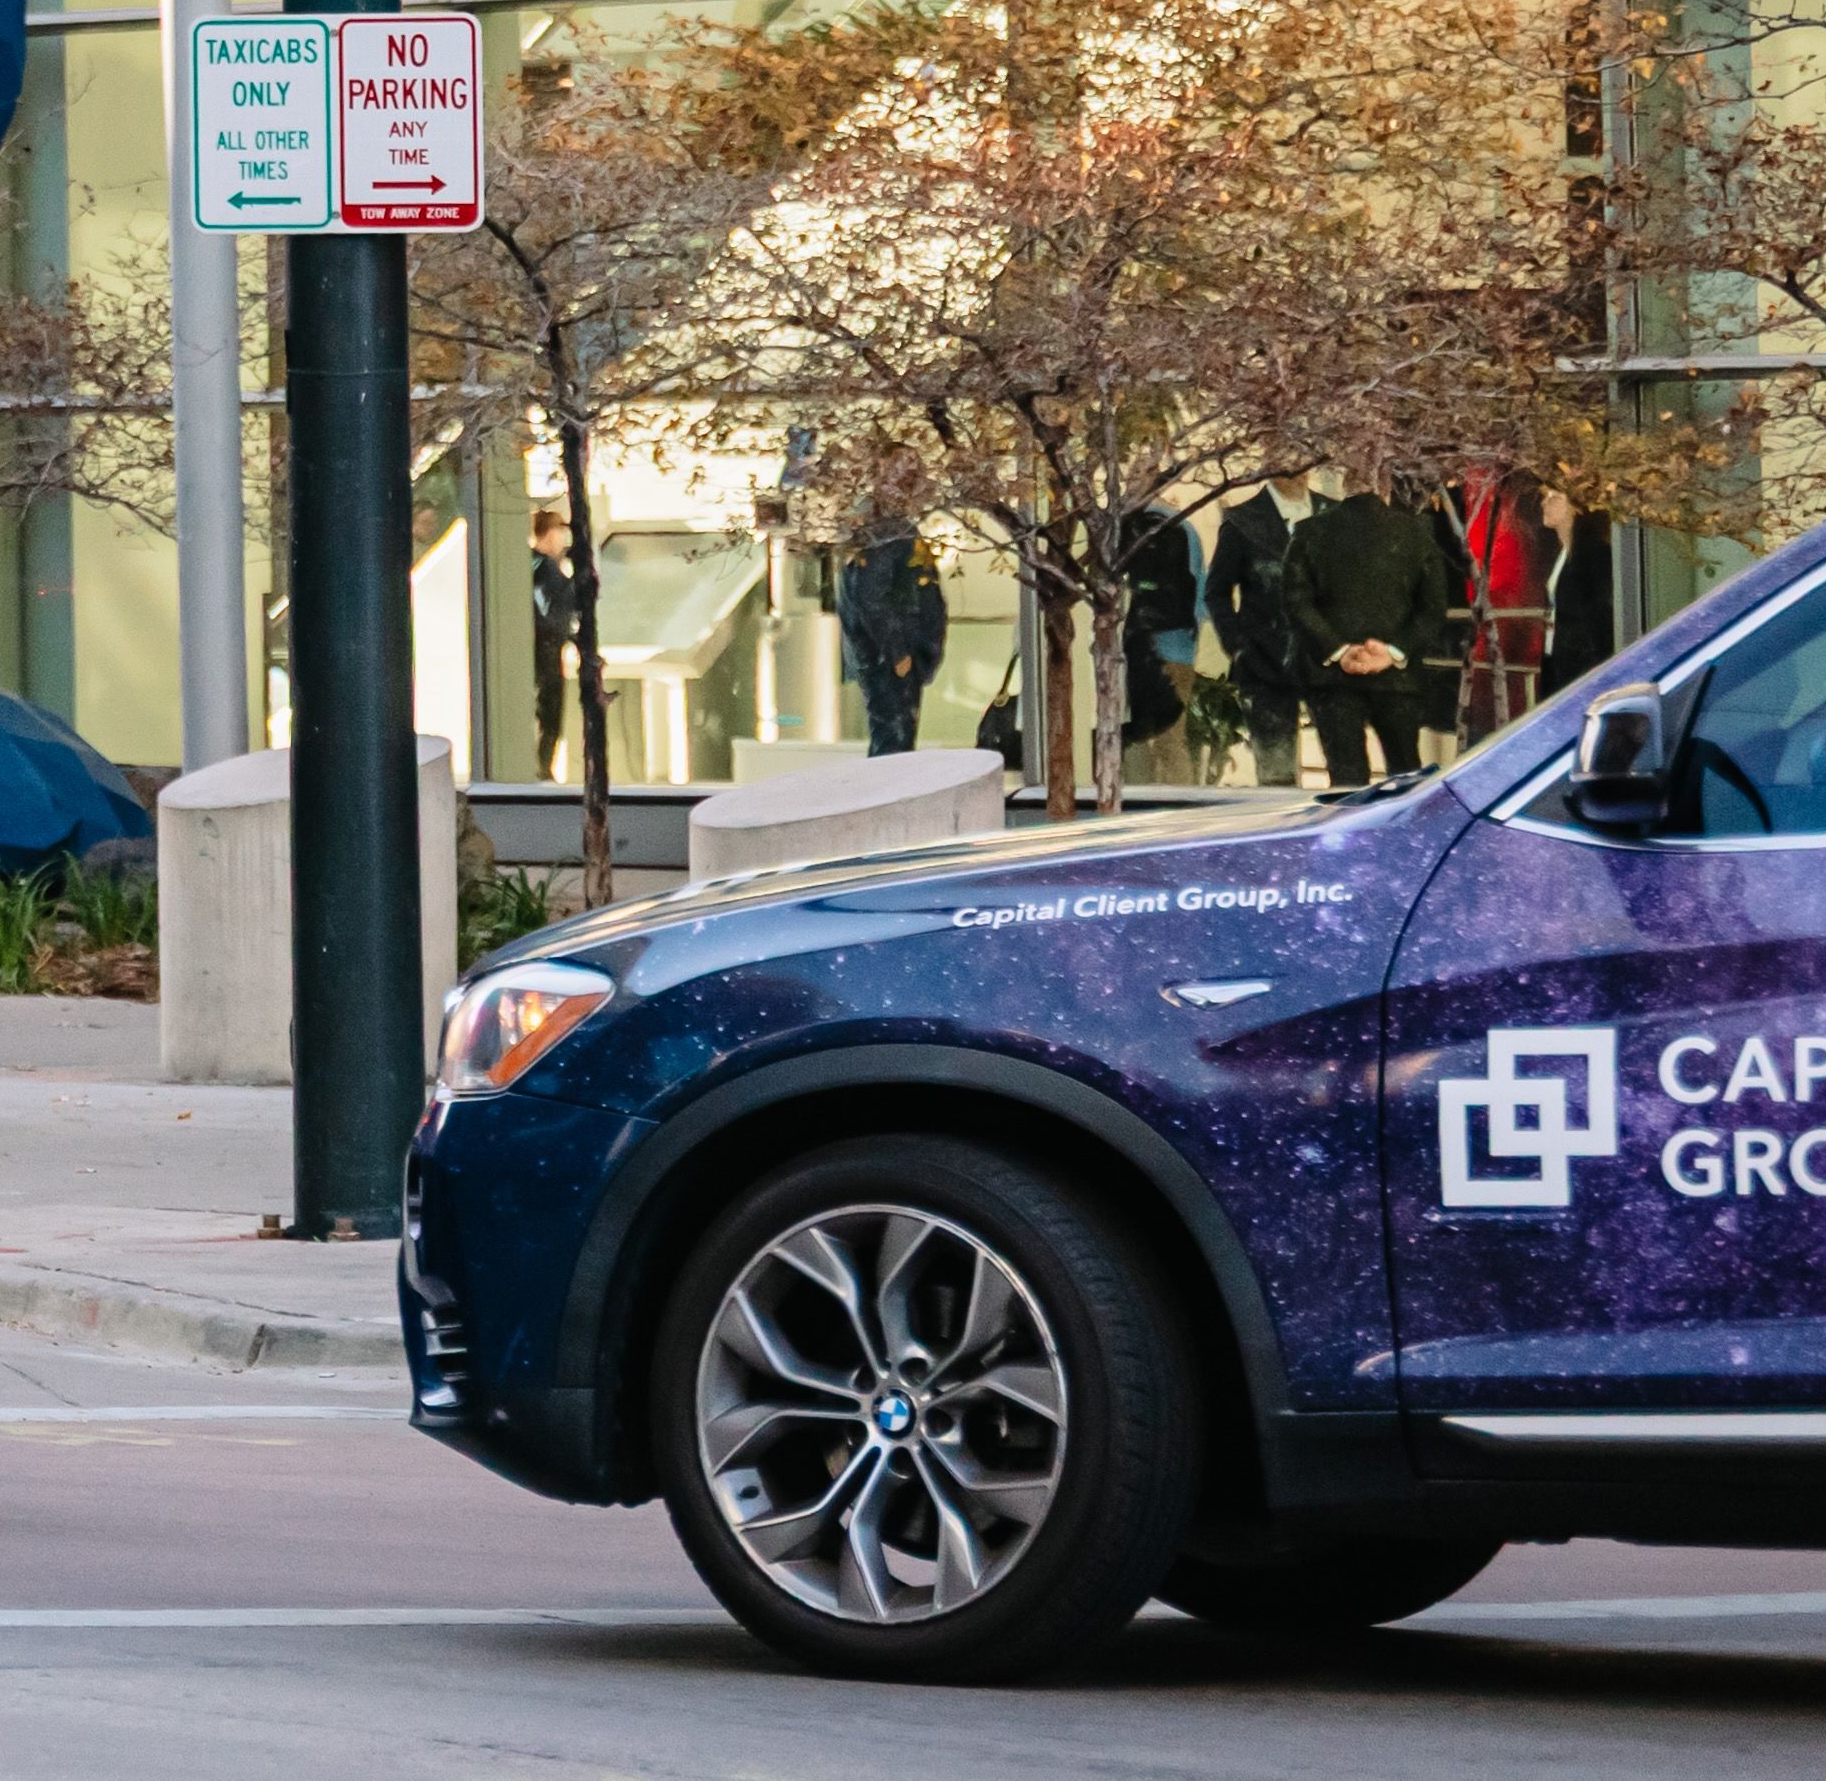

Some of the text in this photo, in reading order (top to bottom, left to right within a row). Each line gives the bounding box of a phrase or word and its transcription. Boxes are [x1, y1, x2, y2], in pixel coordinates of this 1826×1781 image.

[205, 38, 318, 64] TAXICABS
[388, 34, 429, 68] NO
[232, 81, 291, 106] ONLY
[348, 78, 468, 110] PARKING
[216, 131, 309, 150] ALL OTHER
[389, 121, 428, 138] ANY
[389, 149, 429, 165] TIME
[238, 161, 288, 180] TIMES
[361, 207, 460, 219] TOW AWAY ZONE
[952, 880, 1353, 930] Capital Client Group, Inc.
